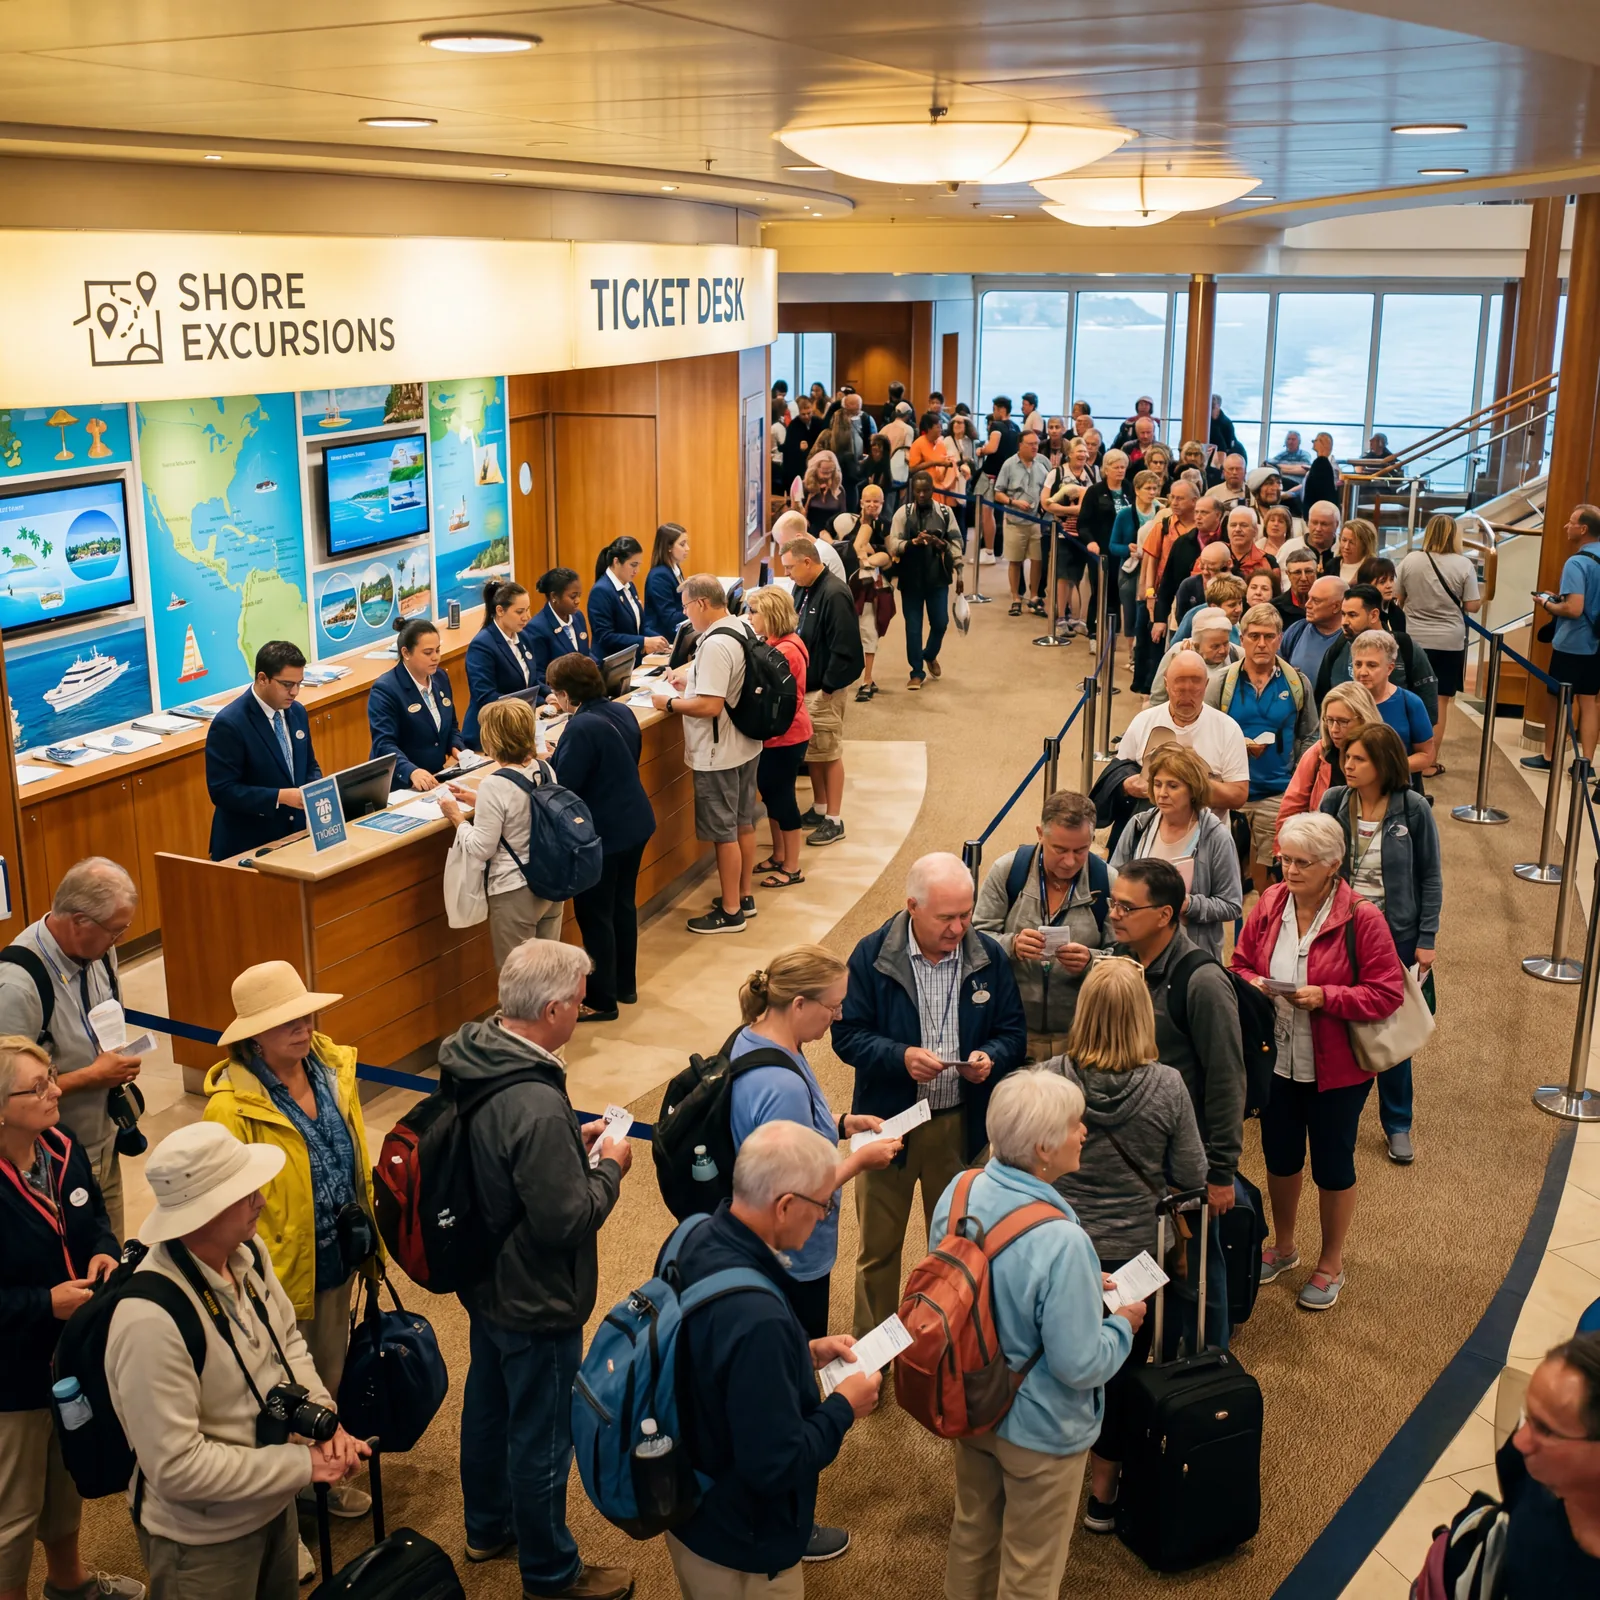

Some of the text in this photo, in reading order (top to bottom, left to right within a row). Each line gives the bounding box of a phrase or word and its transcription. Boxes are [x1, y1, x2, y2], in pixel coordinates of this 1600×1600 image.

[178, 272, 306, 312] SHORE
[590, 277, 745, 331] TICKET DESK
[182, 317, 395, 361] EXCURSIONS
